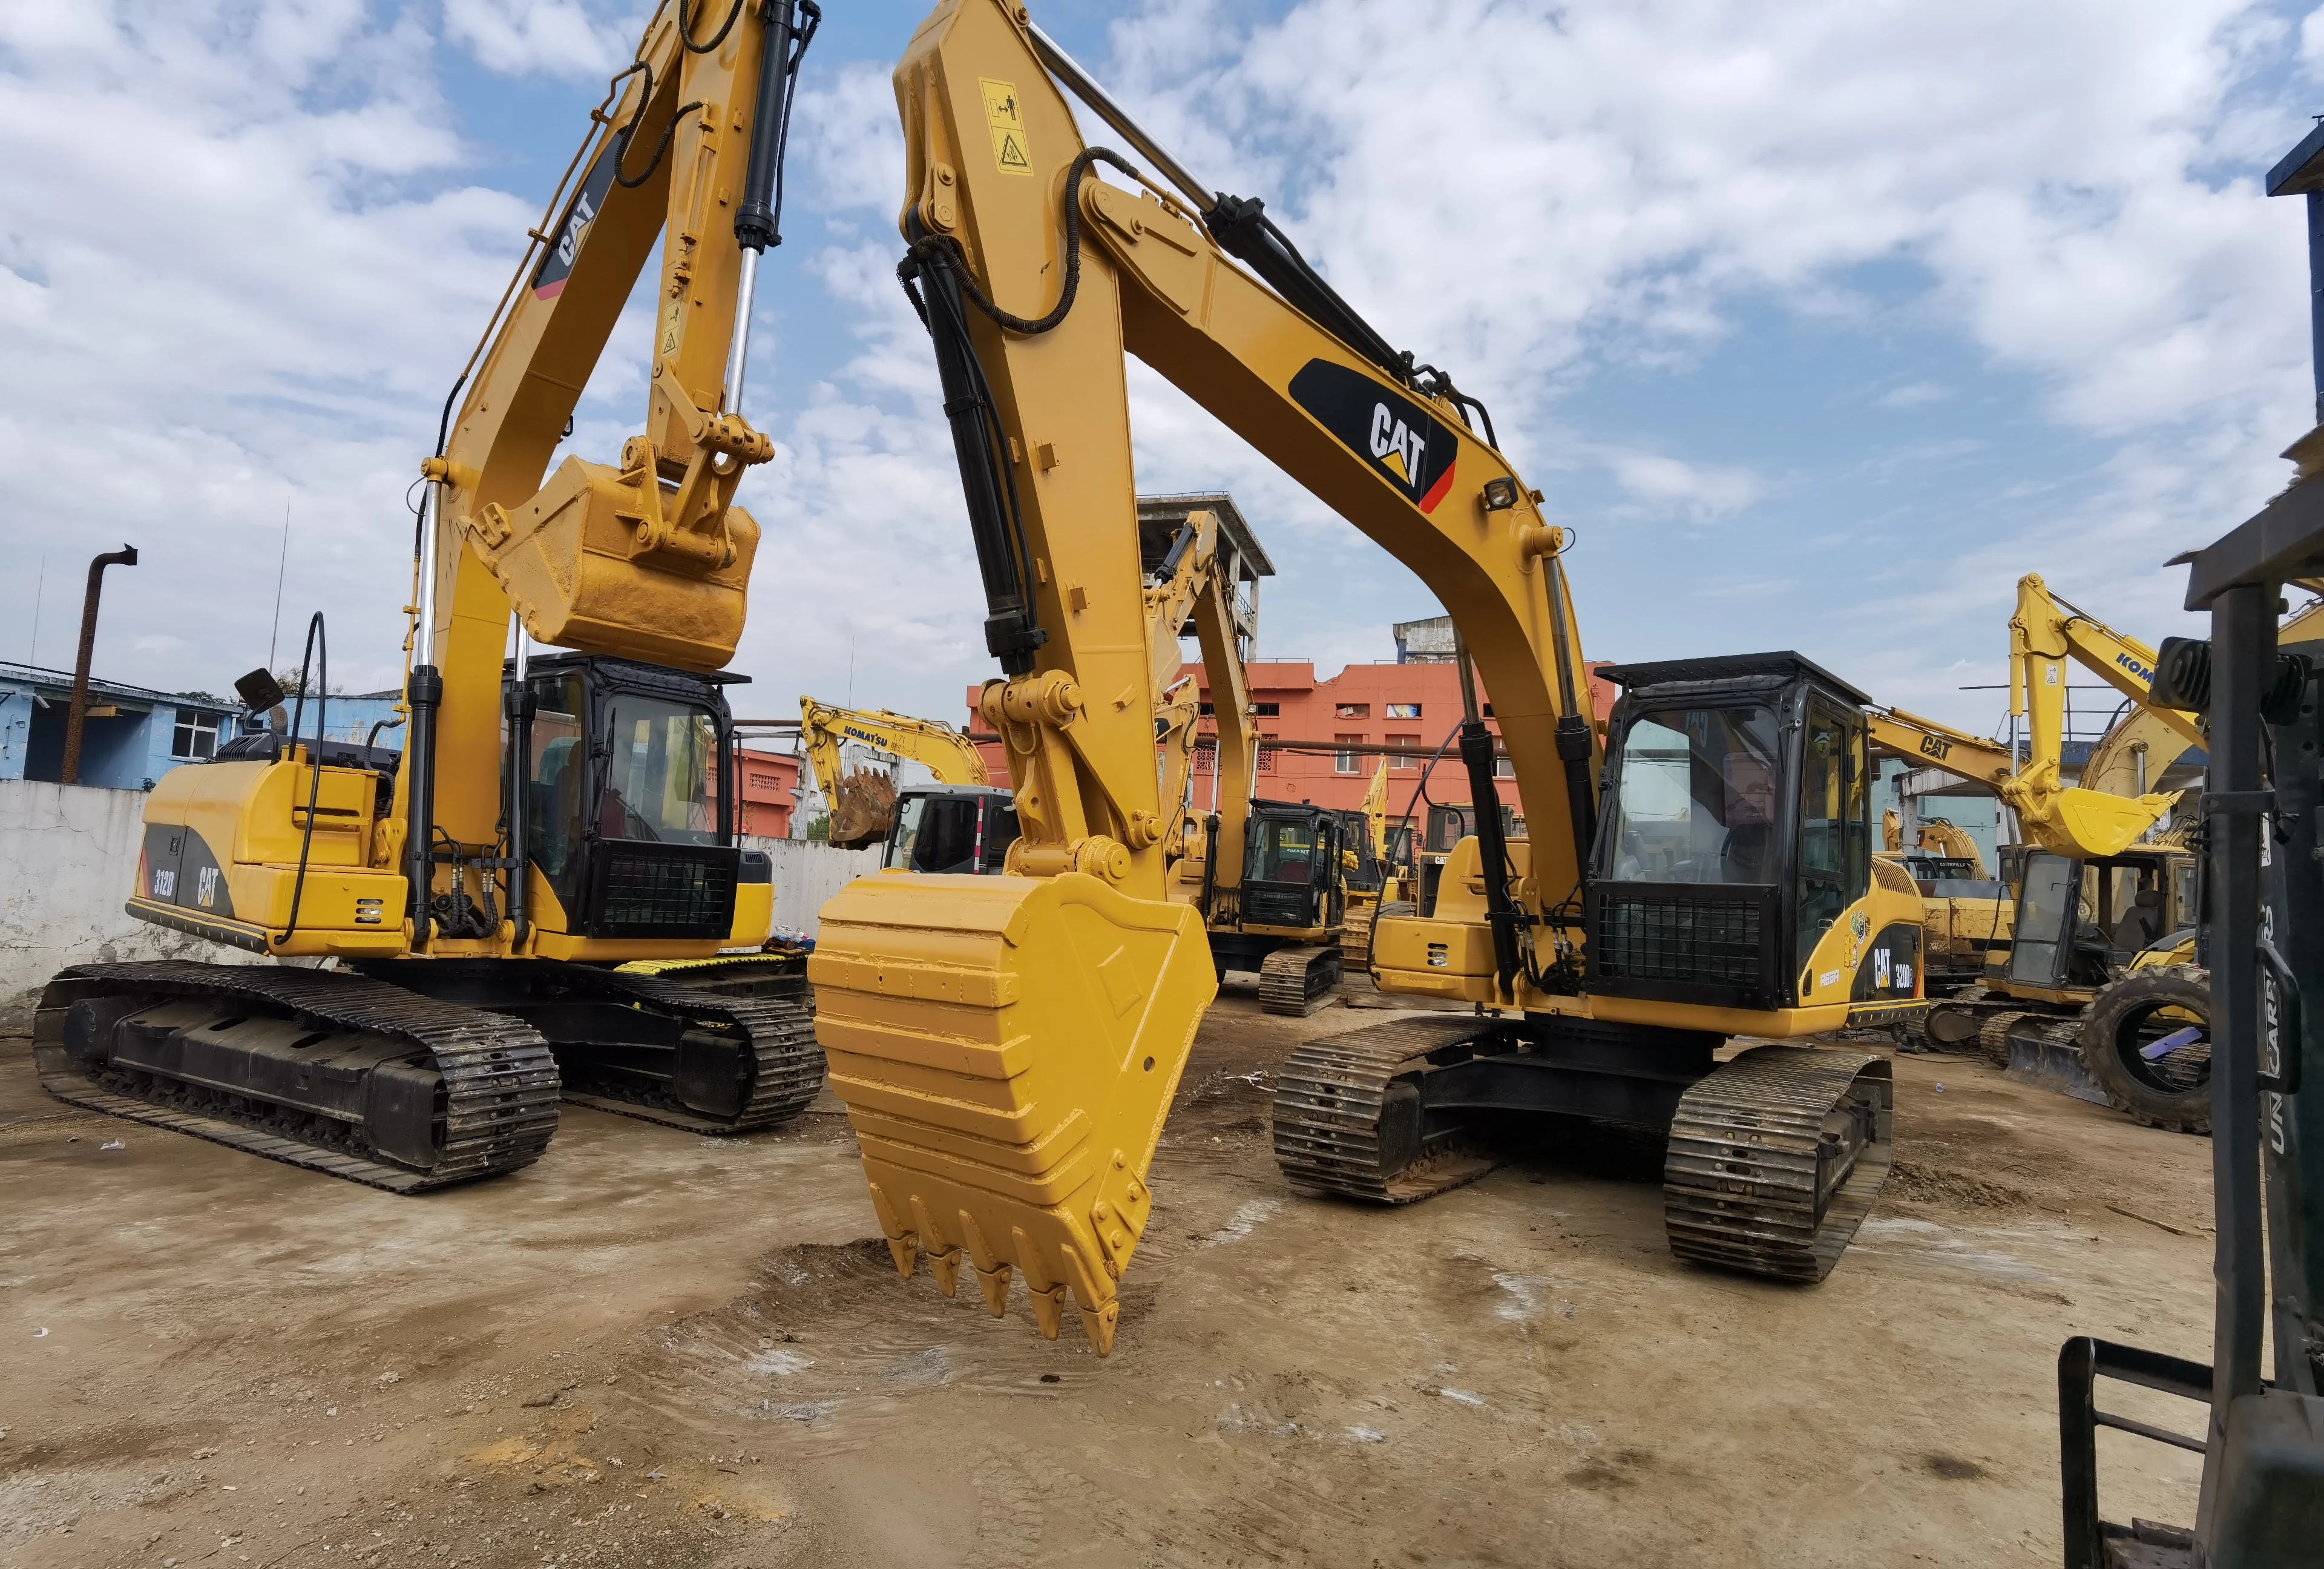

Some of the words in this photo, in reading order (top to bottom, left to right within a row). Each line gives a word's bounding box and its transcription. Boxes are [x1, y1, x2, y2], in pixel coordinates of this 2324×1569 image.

[558, 191, 594, 266] CAT
[1370, 403, 1425, 488] CAT
[844, 725, 888, 747] KOMATSU
[1920, 735, 1953, 761] CAT
[154, 869, 174, 896] 312D
[197, 866, 218, 907] CAT
[1874, 948, 1891, 989] CAT
